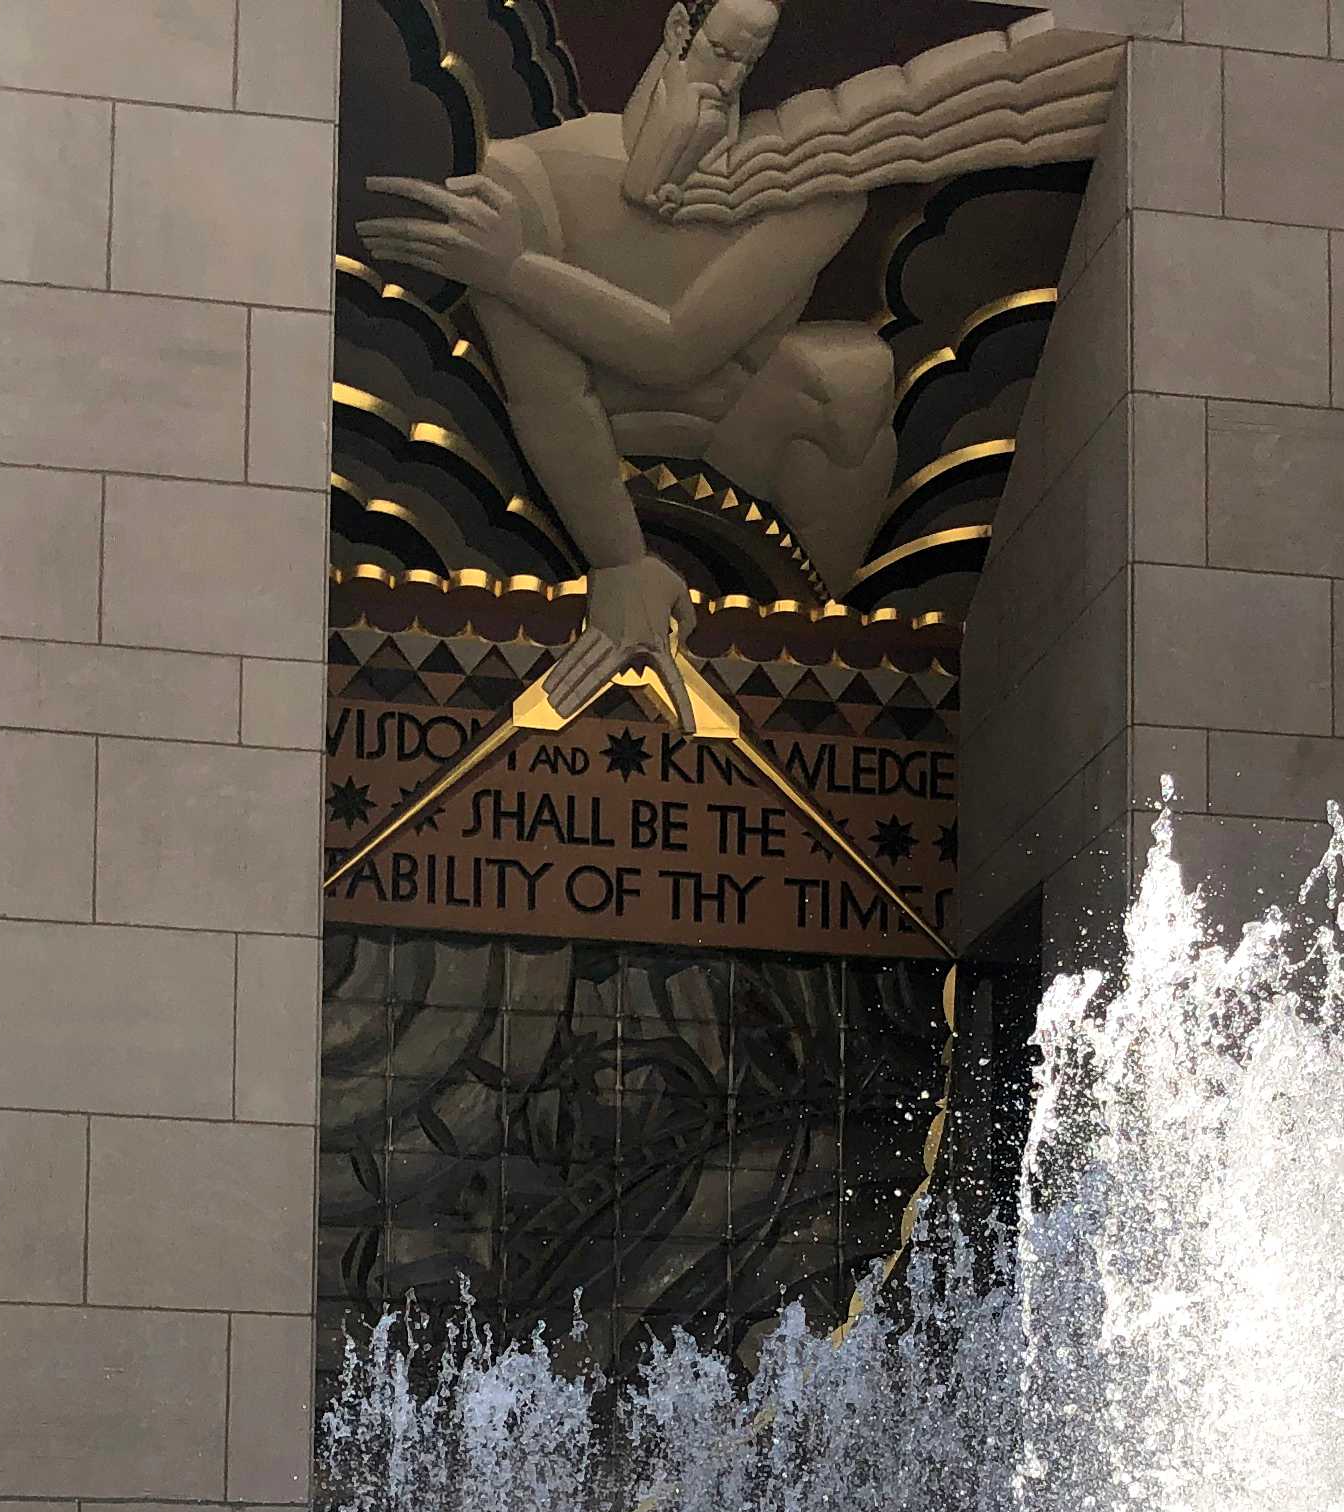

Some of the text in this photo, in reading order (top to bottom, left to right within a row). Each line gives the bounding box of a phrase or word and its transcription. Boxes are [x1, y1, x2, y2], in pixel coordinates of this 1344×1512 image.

[529, 745, 590, 776] AND
[661, 733, 955, 799] KNWLEDGE
[462, 789, 786, 857] SHALL BE THE
[565, 865, 642, 917] OF
[658, 870, 766, 924] THY
